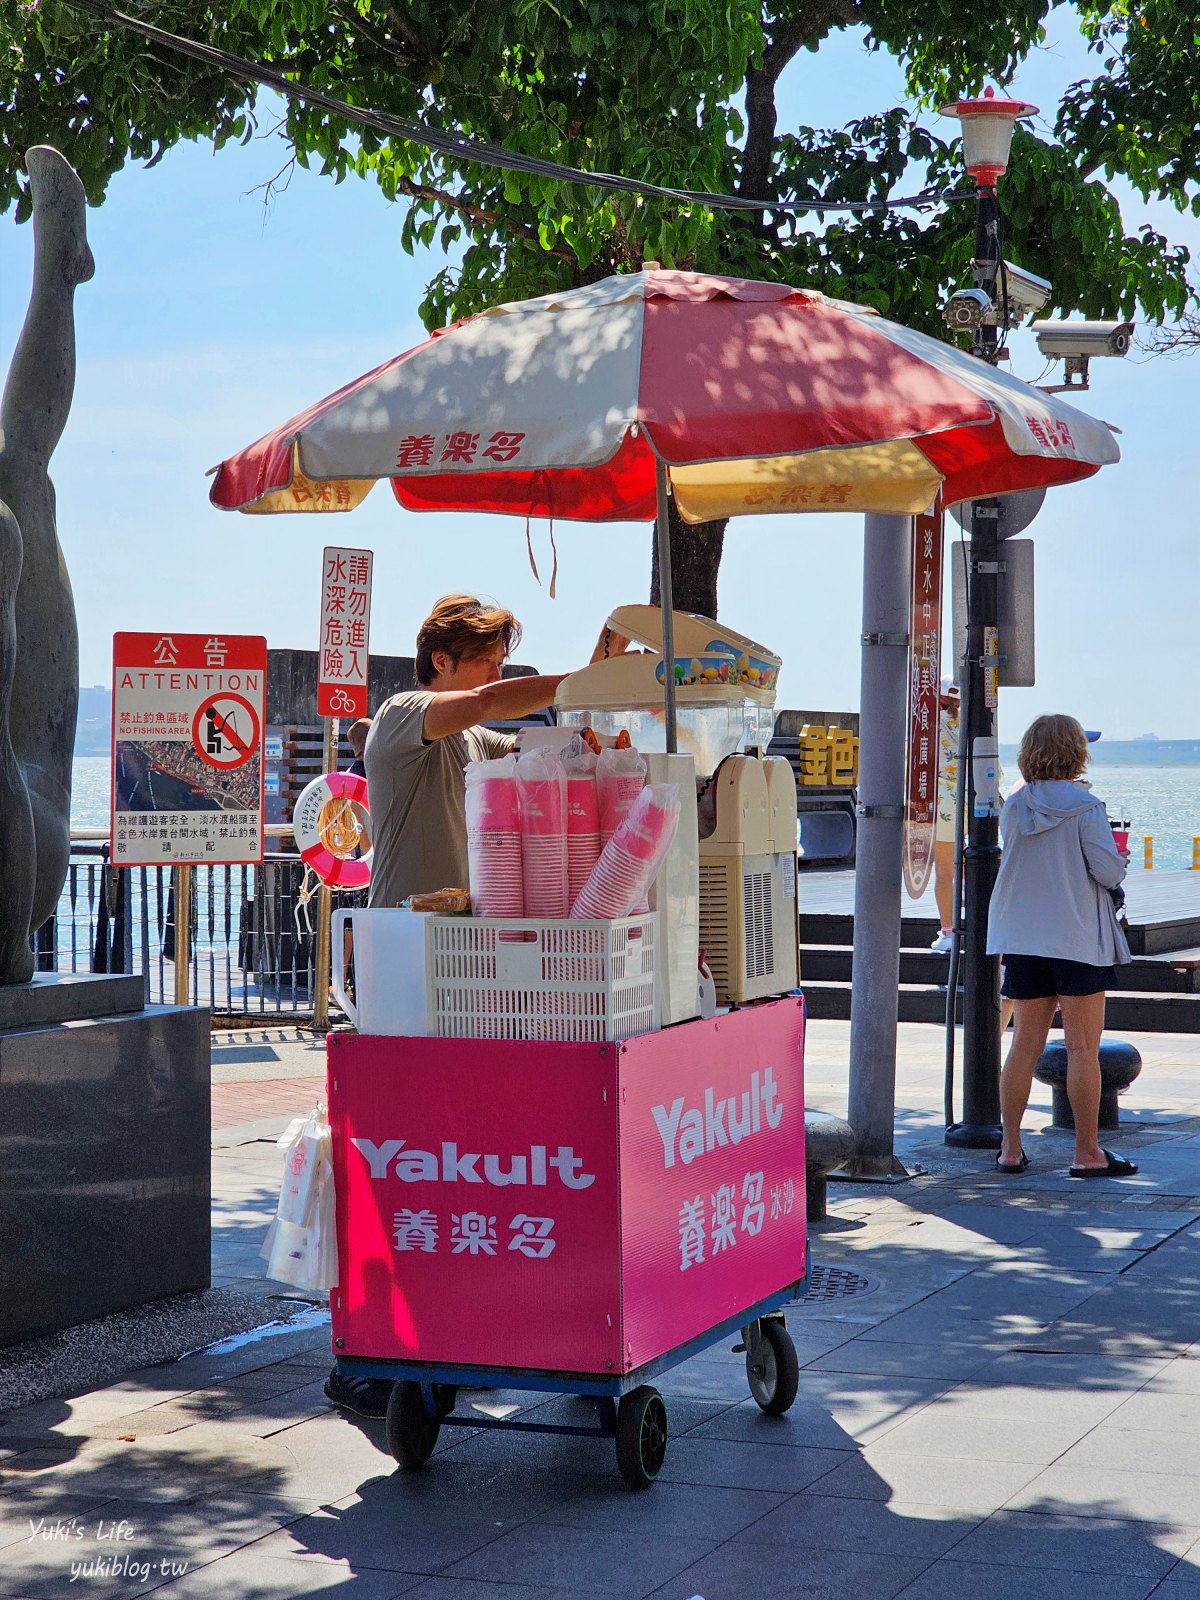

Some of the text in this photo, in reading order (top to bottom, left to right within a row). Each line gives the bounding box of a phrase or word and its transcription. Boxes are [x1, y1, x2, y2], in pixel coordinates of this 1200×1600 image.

[324, 553, 347, 678] 水深危險
[345, 555, 367, 679] 請勿進入
[153, 637, 229, 666] 公告
[917, 529, 934, 800] 淡水中正美食廣場
[121, 673, 258, 691] ATTENTION
[120, 712, 189, 724] 禁止釣魚區域
[134, 727, 166, 735] FISHING
[168, 727, 191, 735] AREA
[118, 828, 258, 839] 金色水岸舞台間水域，禁止釣魚
[651, 1066, 783, 1169] Yakult
[350, 1138, 596, 1190] Yakult
[770, 1177, 795, 1221] 冰沙
